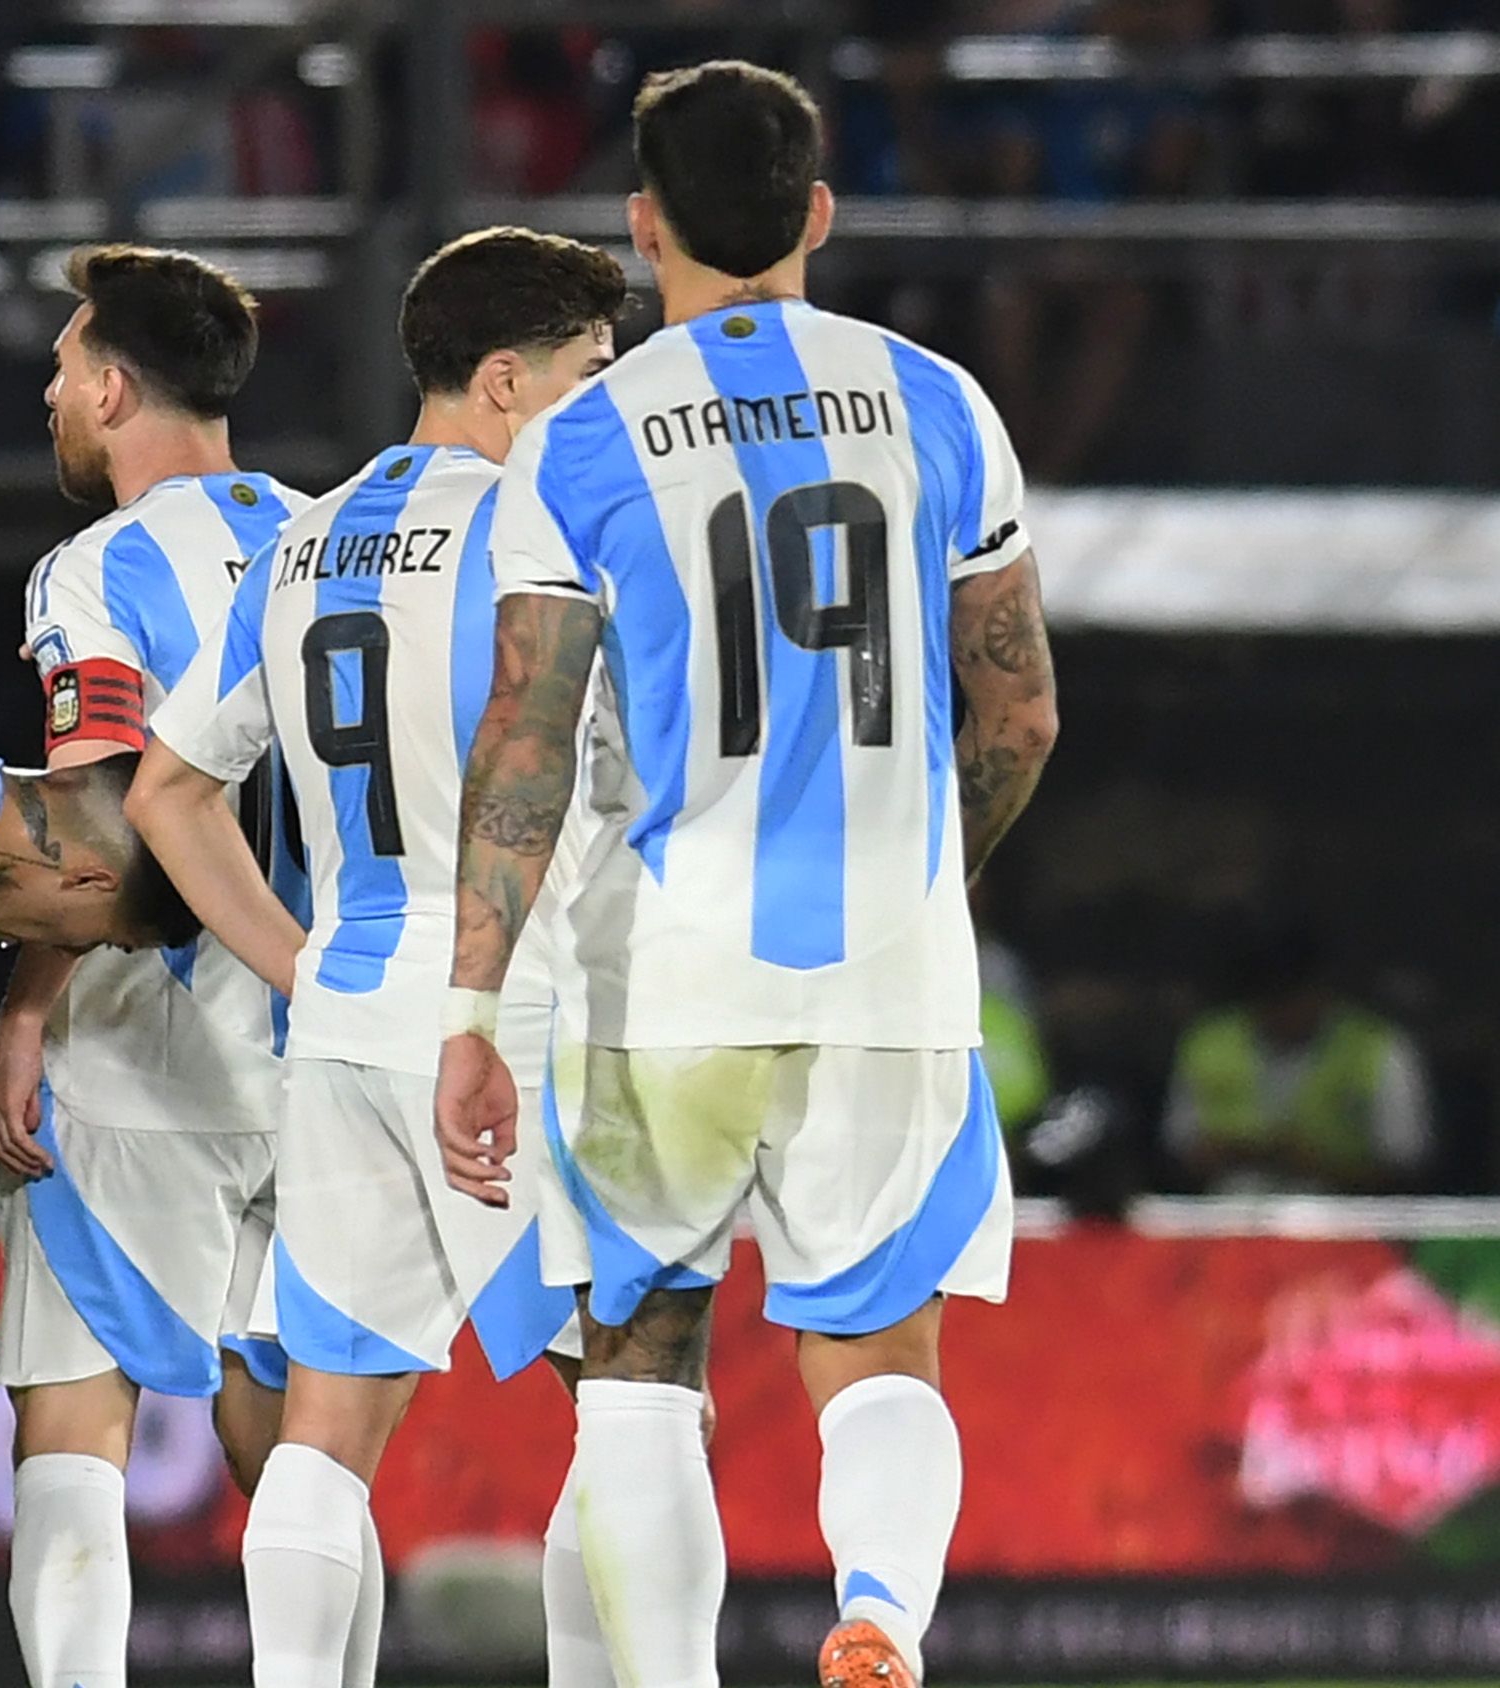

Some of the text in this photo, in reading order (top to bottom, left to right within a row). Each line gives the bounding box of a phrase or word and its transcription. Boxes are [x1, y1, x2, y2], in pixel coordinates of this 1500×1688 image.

[641, 389, 894, 457] OTAMENDI
[274, 528, 452, 592] J.ALVAREZ
[707, 481, 893, 759] 19
[301, 610, 407, 857] 9
